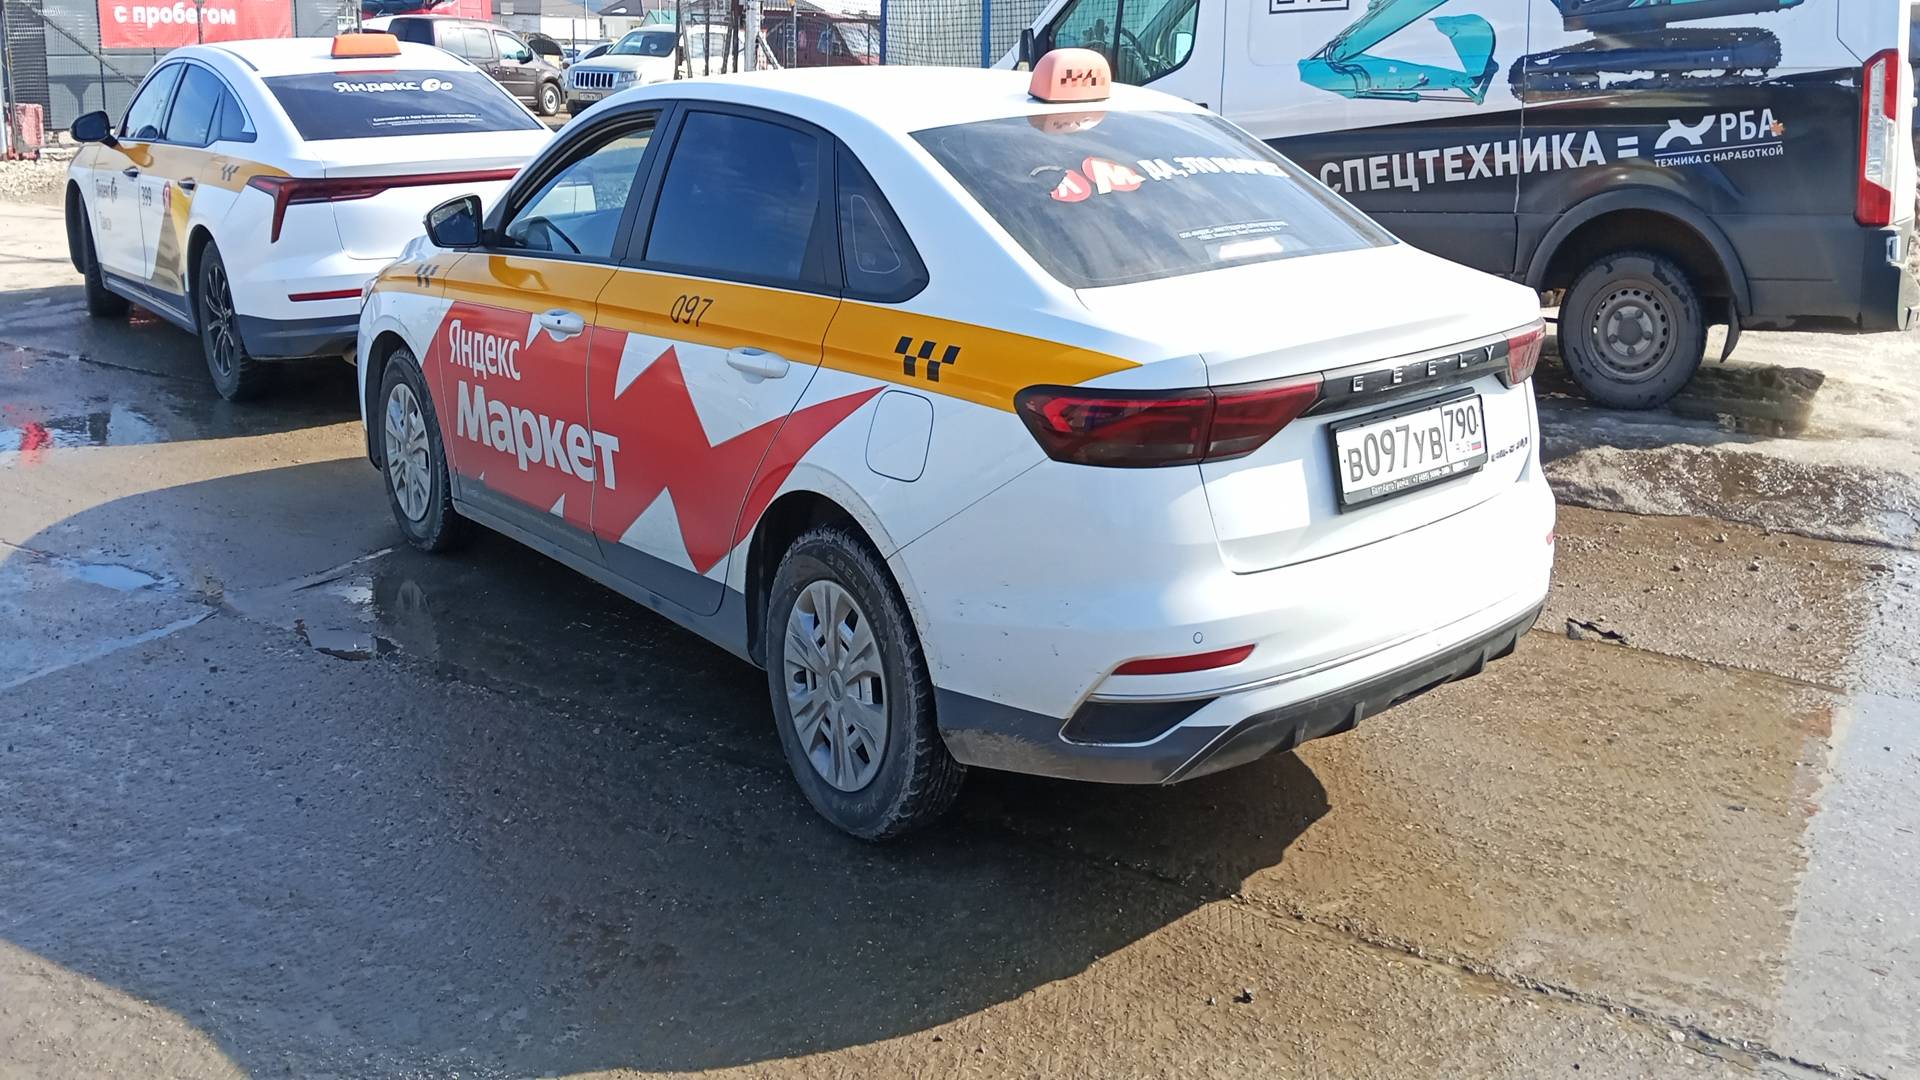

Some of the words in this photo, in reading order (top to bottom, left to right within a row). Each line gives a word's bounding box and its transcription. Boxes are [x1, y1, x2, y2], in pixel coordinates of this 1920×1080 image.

[114, 5, 128, 24] с
[132, 2, 237, 28] пробегом
[333, 81, 420, 93] Яндекс
[421, 78, 453, 92] Go
[1720, 108, 1779, 143] РБА
[1320, 130, 1607, 193] СПЕЦТЕХНИКА
[1654, 154, 1702, 168] ТЕХНИКА
[1704, 154, 1711, 163] С
[1713, 145, 1784, 163] НАРАБОТКОЙ
[670, 295, 714, 327] 097
[449, 319, 521, 381] Яндекс
[1352, 345, 1495, 392] GEELY
[457, 379, 620, 490] Маркет
[1443, 405, 1477, 442] 790
